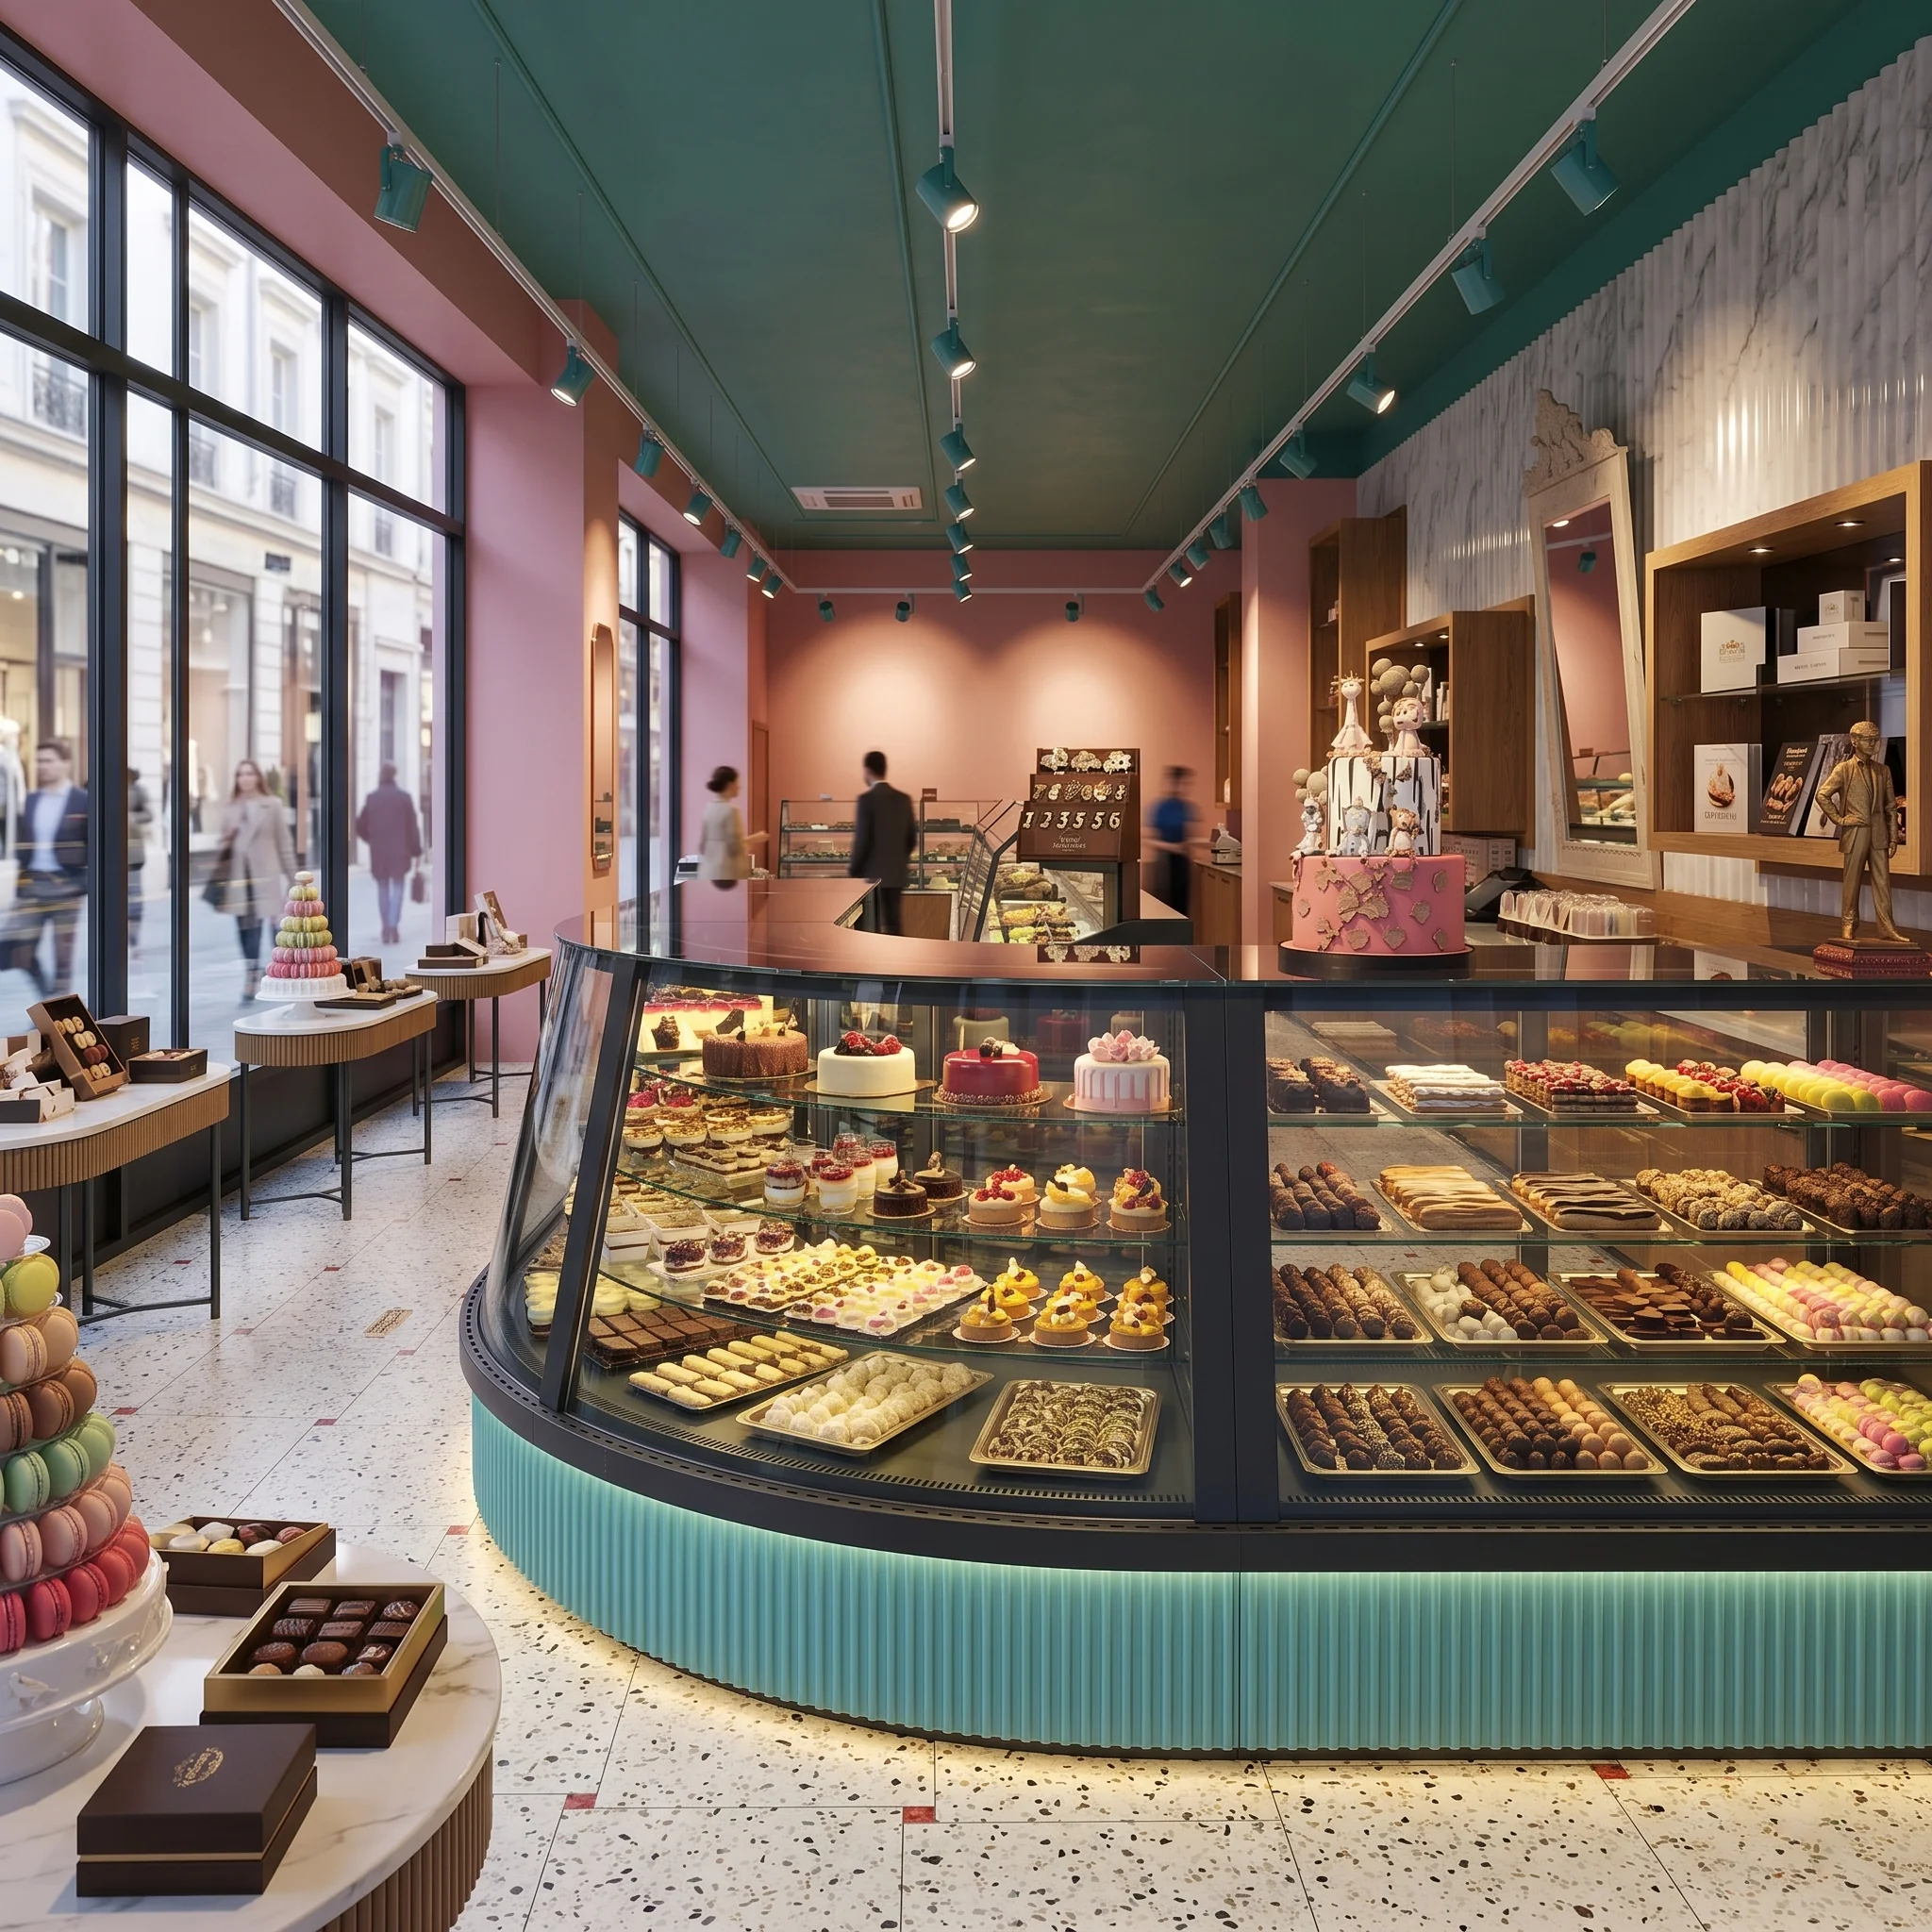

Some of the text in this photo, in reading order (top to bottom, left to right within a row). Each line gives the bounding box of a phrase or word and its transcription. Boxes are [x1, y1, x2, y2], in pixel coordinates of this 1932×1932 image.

[1023, 812, 1121, 829] 1 2 3 5 5 6
